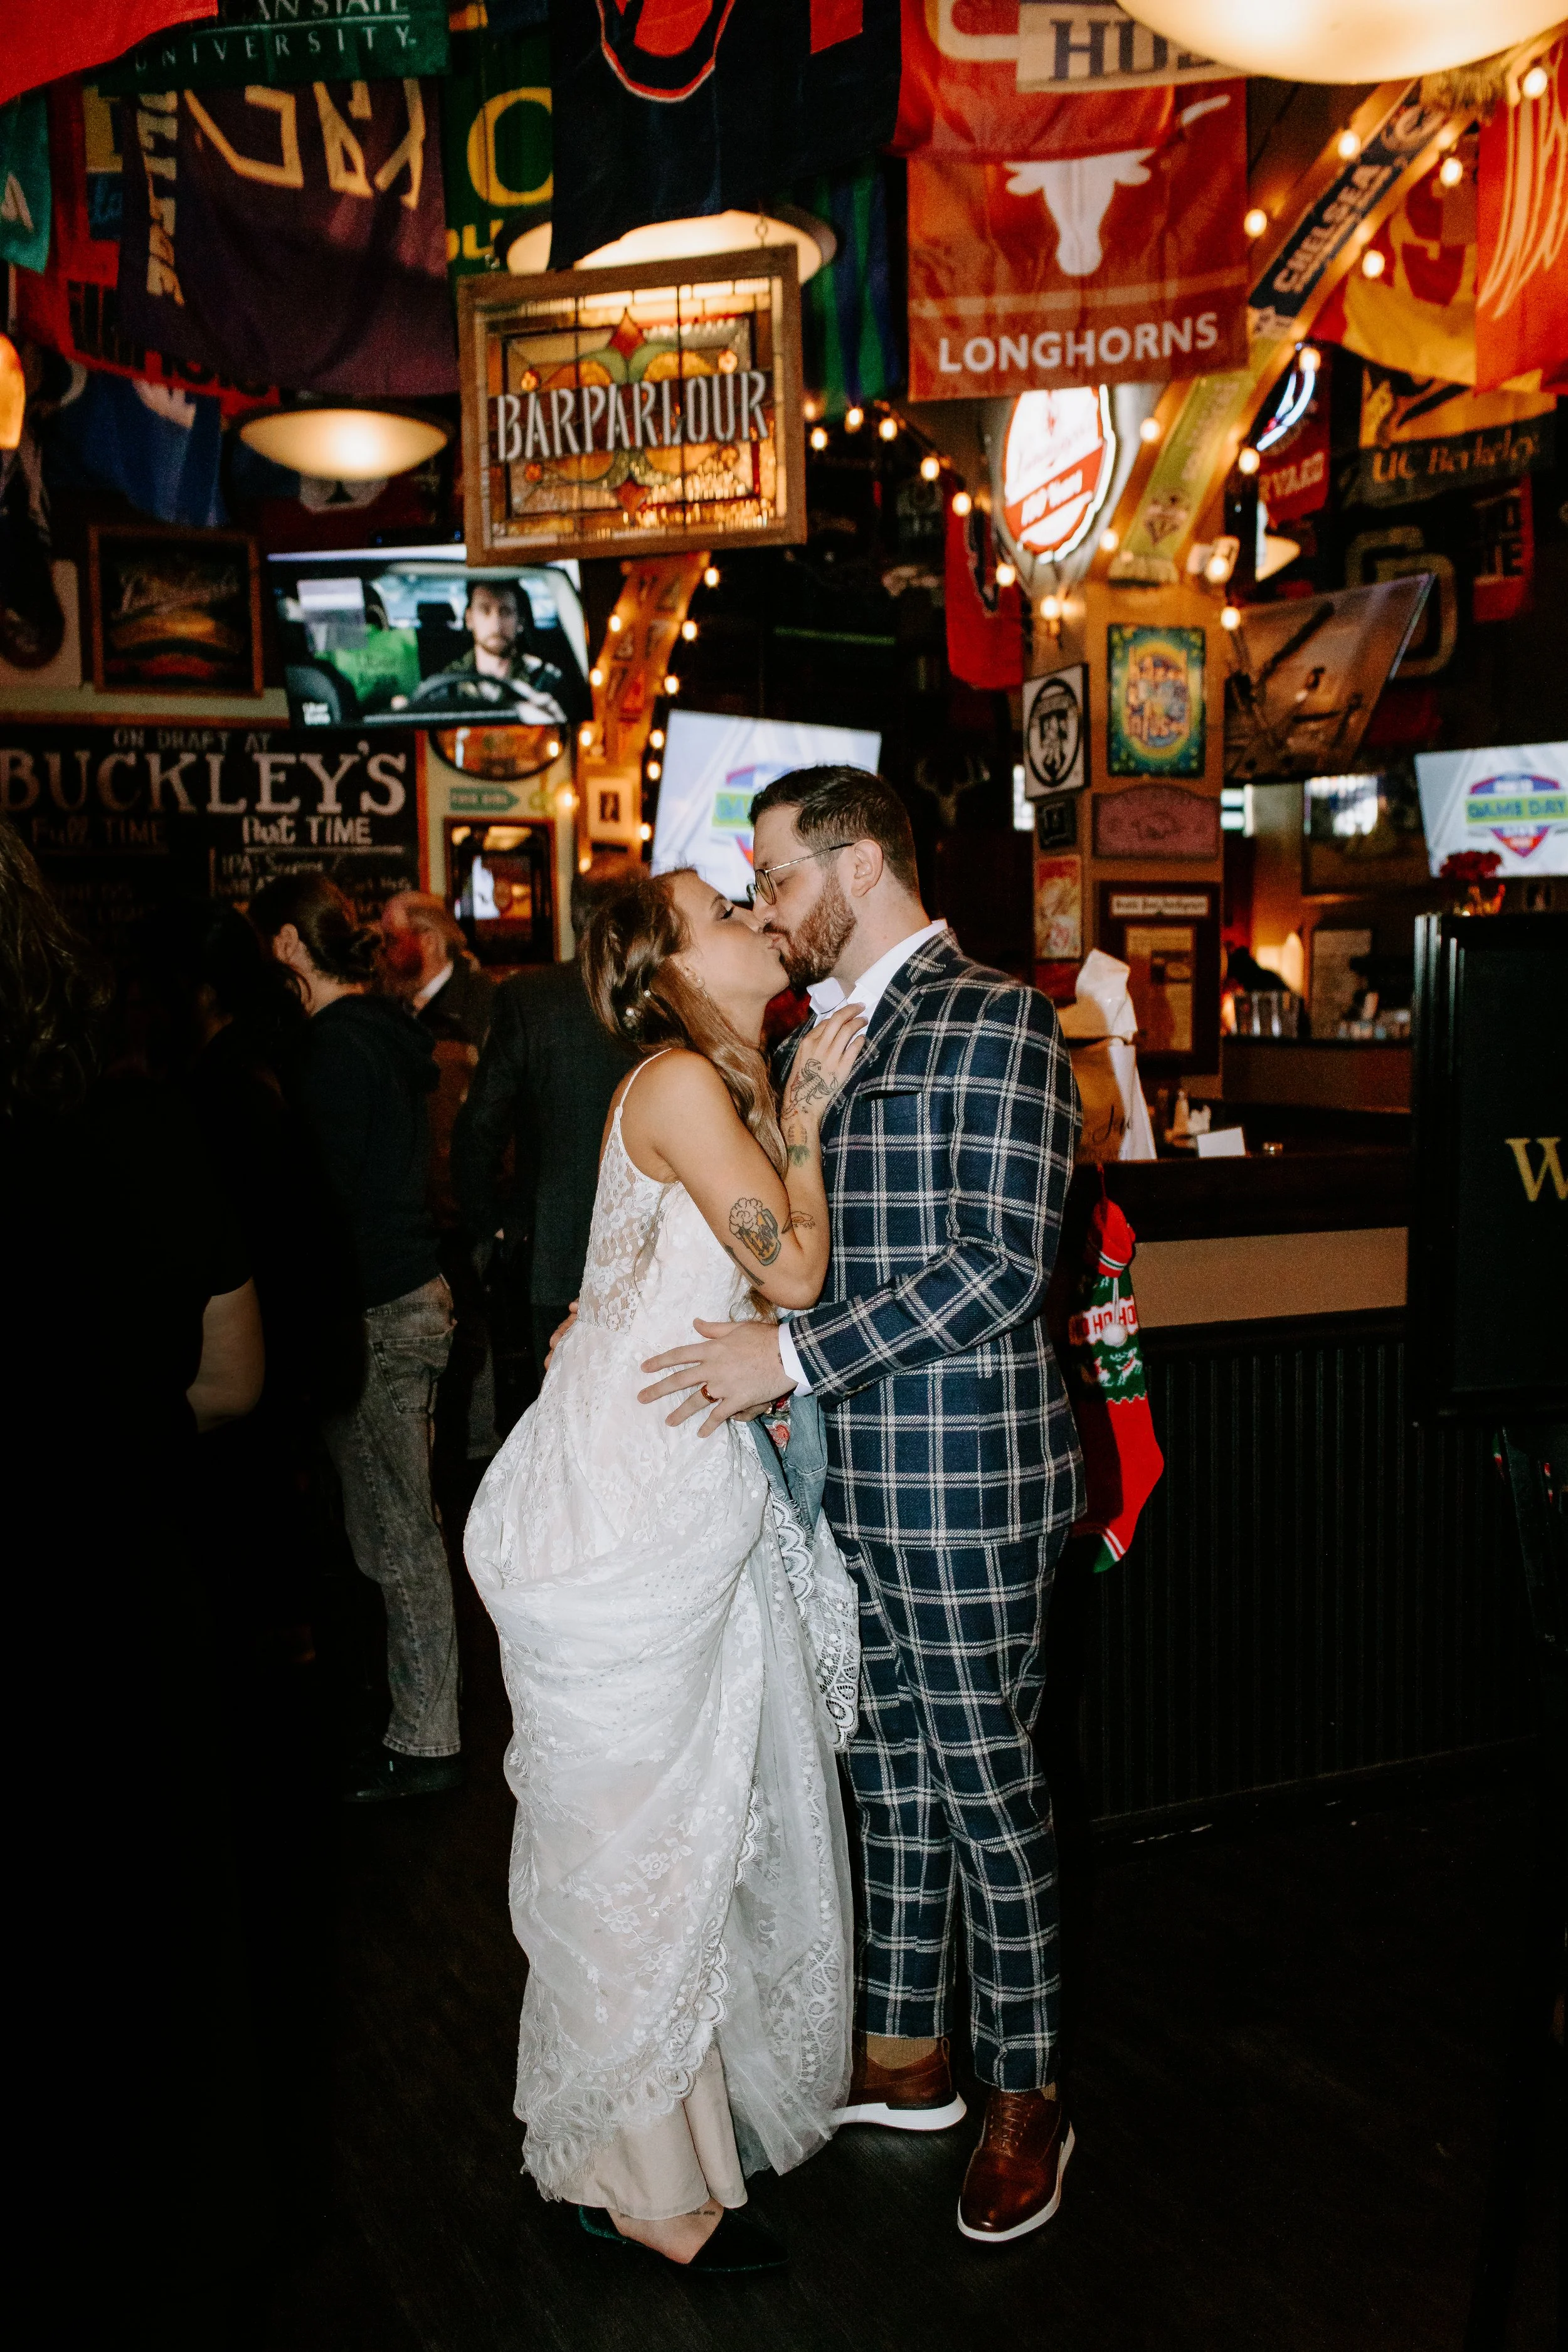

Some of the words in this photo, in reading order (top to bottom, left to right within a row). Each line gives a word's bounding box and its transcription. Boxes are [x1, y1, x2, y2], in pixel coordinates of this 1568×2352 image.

[1273, 164, 1396, 293] CHELSEA
[938, 312, 1219, 373] LONGHORNS
[112, 728, 146, 750] ON
[156, 728, 231, 753] DRAFT
[243, 731, 272, 754] AT
[0, 740, 407, 817] BUCKLEY'S
[305, 815, 373, 845] TIME
